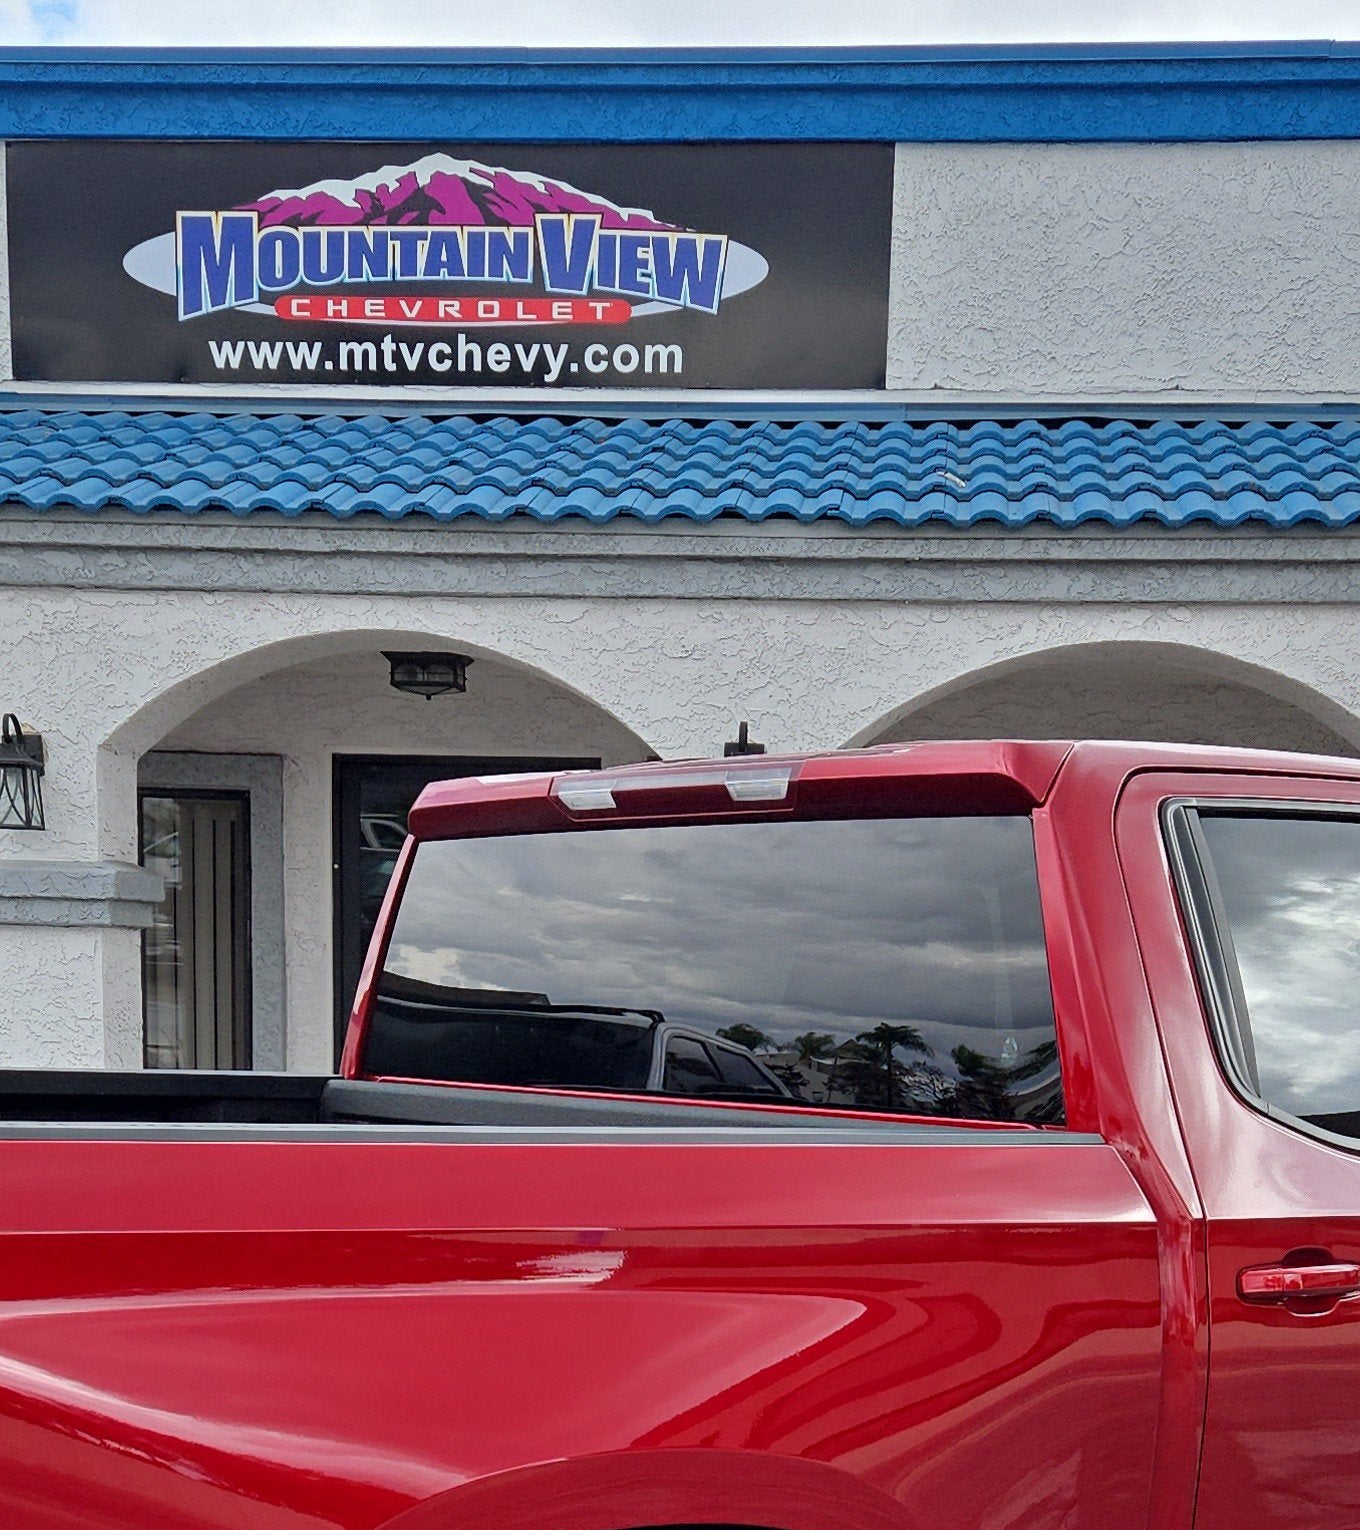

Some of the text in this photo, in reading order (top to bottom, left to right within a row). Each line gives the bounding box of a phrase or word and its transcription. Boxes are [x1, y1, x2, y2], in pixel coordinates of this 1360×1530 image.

[174, 210, 729, 321] MOUNTAIN VIEW
[290, 298, 611, 321] CHEVROLET
[209, 337, 684, 382] www.mtvchevy.com
